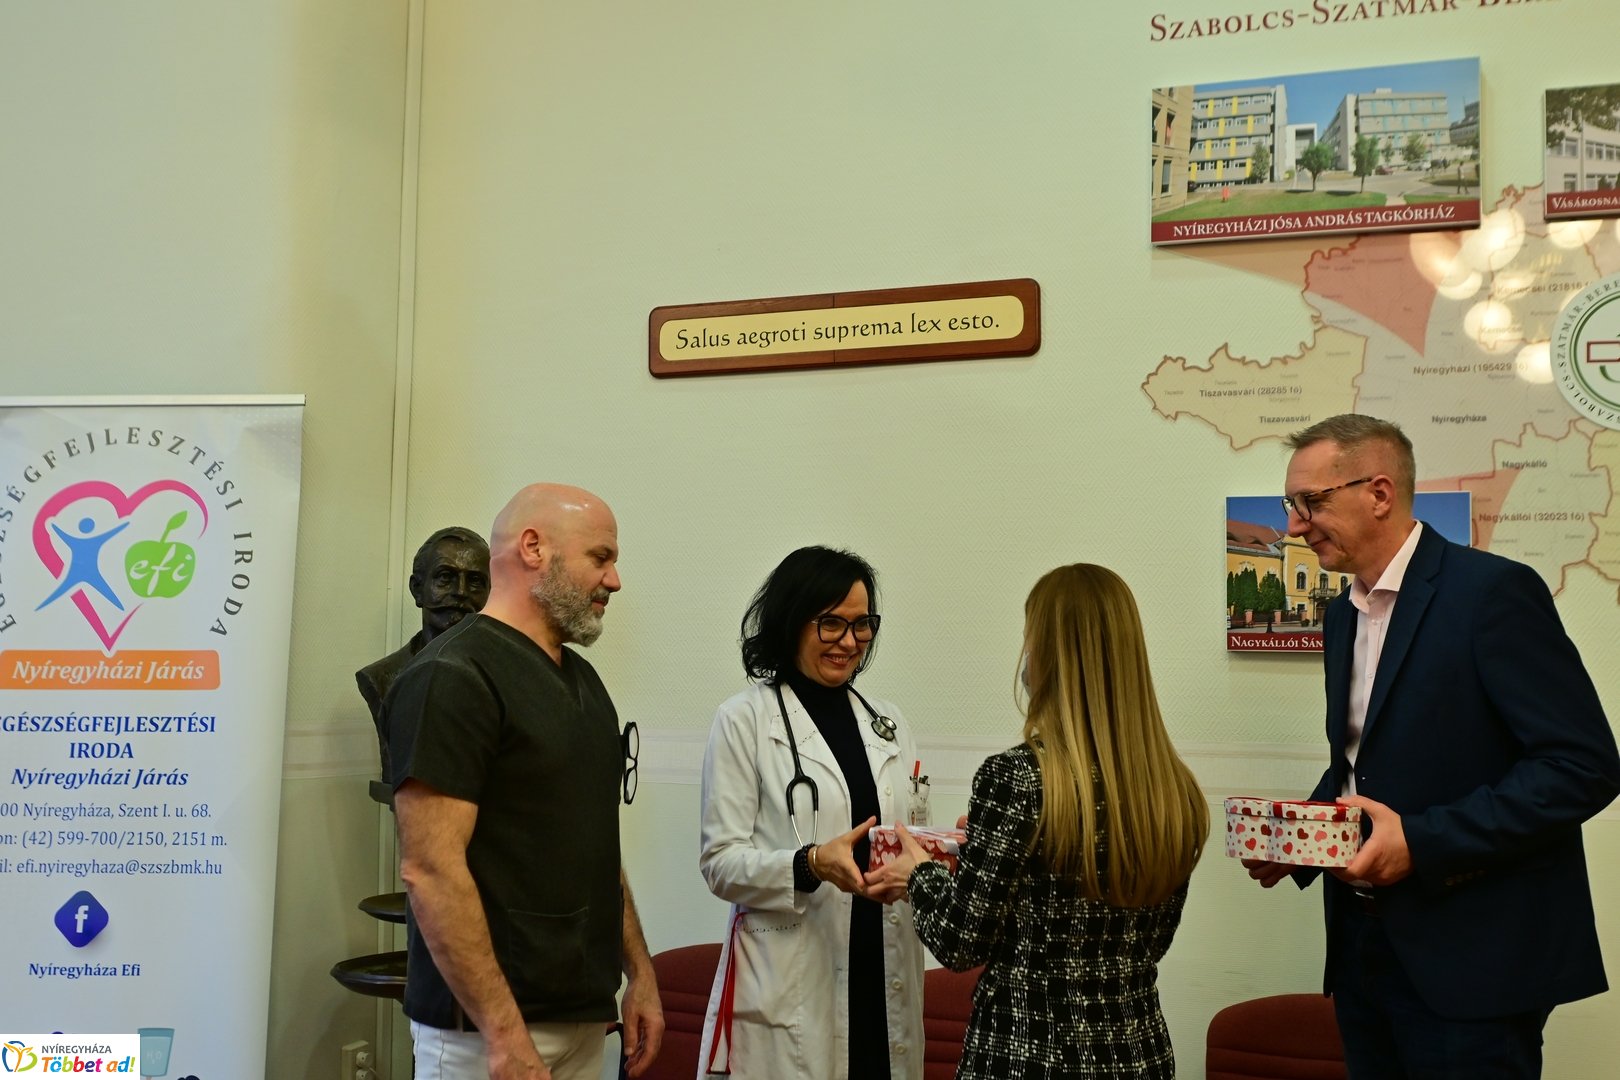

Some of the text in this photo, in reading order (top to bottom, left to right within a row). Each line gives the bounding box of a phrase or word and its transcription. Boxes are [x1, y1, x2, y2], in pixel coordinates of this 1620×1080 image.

[1552, 196, 1620, 209] VÁSÁROSNA
[1173, 205, 1455, 238] NYÍREGYHÁZI JÓSA ANDRÁS TAGKÓRHÁZ
[675, 311, 1000, 350] Salus aegroti suprema lex esto.
[129, 543, 192, 596] efi
[209, 531, 253, 638] IRODA
[1231, 635, 1299, 648] NAGYKÁLLÓI
[12, 660, 205, 685] Nyíregyházi Járás
[0, 711, 216, 736] GÉSZSÉGFEJLESZTÉSI
[69, 742, 134, 759] IRODA
[11, 768, 189, 790] Nyíregyházi Járás
[23, 803, 114, 821] Nyíregyháza,
[118, 803, 159, 818] Szent
[175, 808, 187, 818] u.
[191, 803, 211, 818] 68.
[22, 830, 53, 849] (42)
[57, 830, 168, 849] 599-700/2150,
[172, 831, 206, 846] 2151
[211, 835, 227, 846] m.
[16, 858, 222, 878] efi.nyiregyhaza@szszbmk.hu
[28, 963, 141, 979] Nyíregyháza Efi
